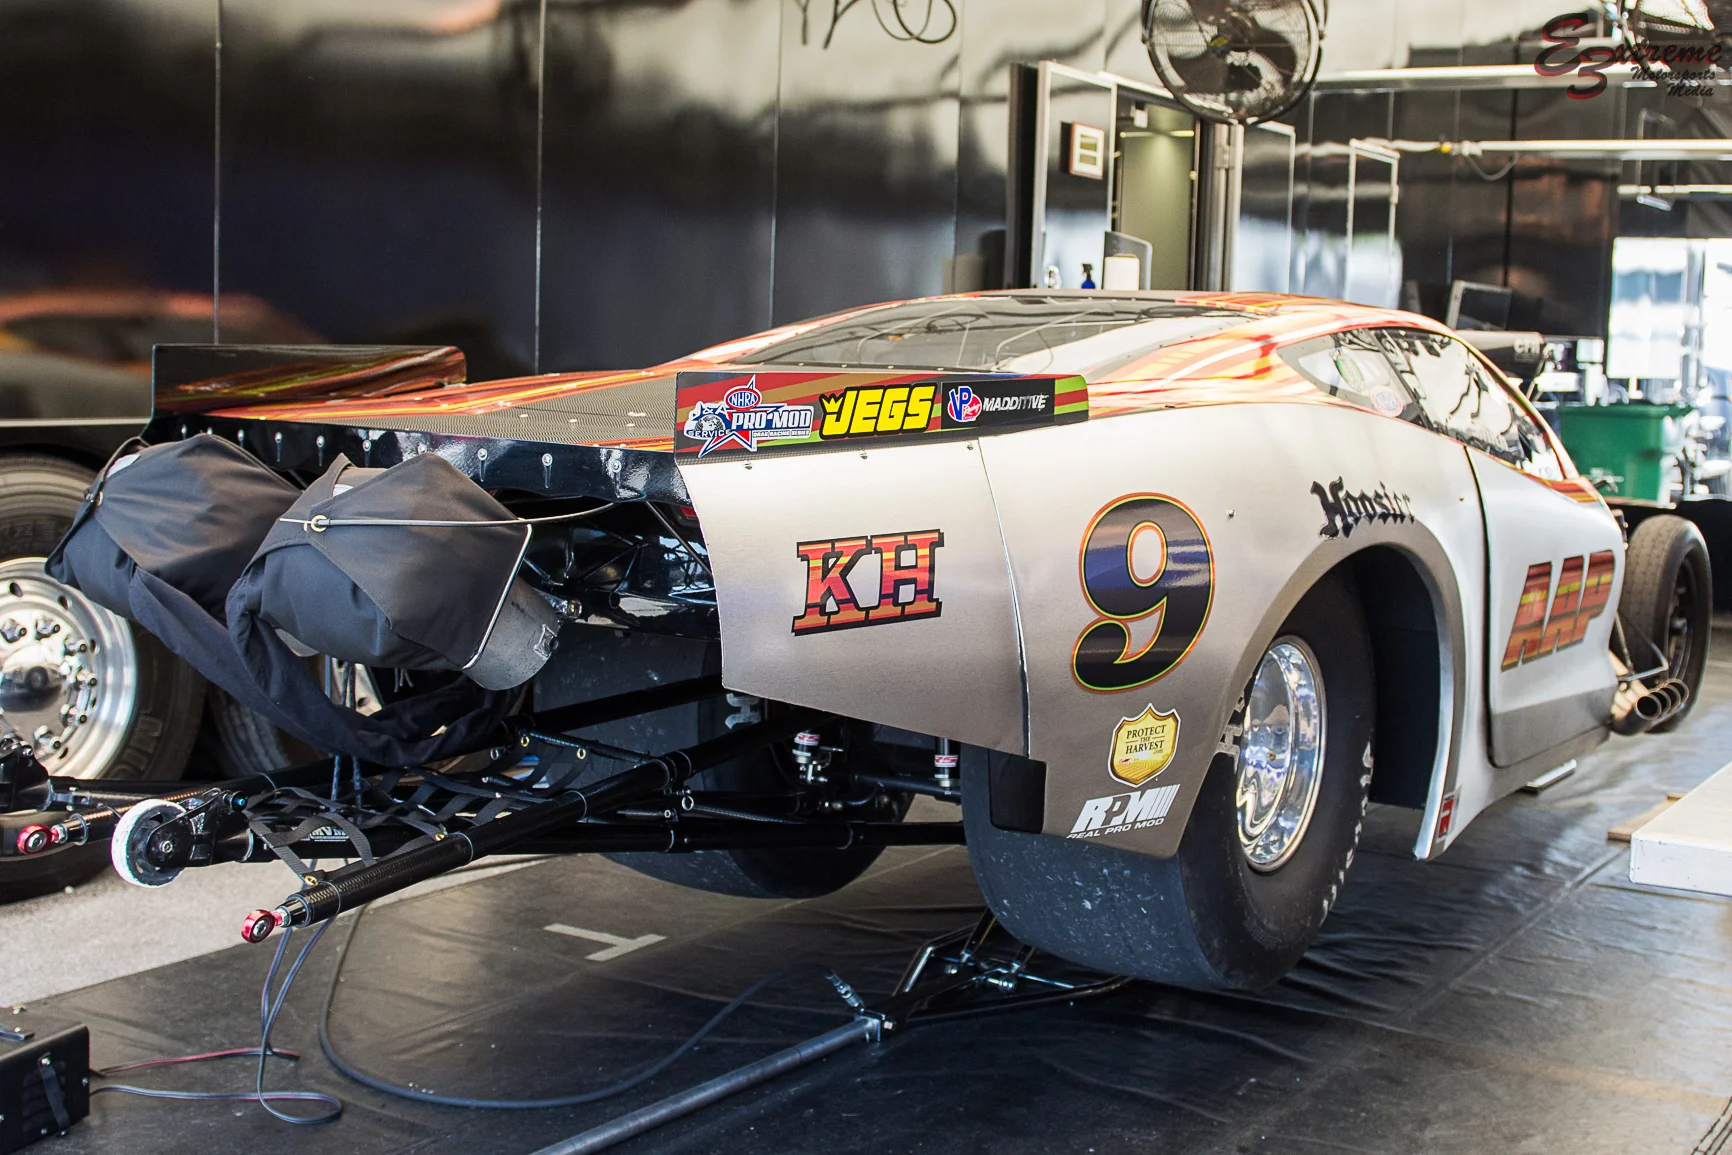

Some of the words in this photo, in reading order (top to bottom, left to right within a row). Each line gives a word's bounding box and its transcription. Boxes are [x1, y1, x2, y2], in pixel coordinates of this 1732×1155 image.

[731, 391, 757, 407] NHRA
[823, 385, 936, 438] JEGS
[949, 386, 973, 421] VP
[983, 393, 1049, 412] MADDITIVE
[730, 411, 764, 430] PRO
[772, 409, 812, 429] MOD
[792, 528, 945, 636] KH
[1071, 493, 1215, 693] 9
[1500, 549, 1616, 673] AAP
[1126, 723, 1167, 739] PROTECT
[1125, 739, 1165, 754] HARVEST
[1070, 783, 1181, 834] RPM
[1065, 829, 1101, 840] REAL
[1104, 824, 1131, 836] PRO
[1134, 817, 1165, 830] MOD
